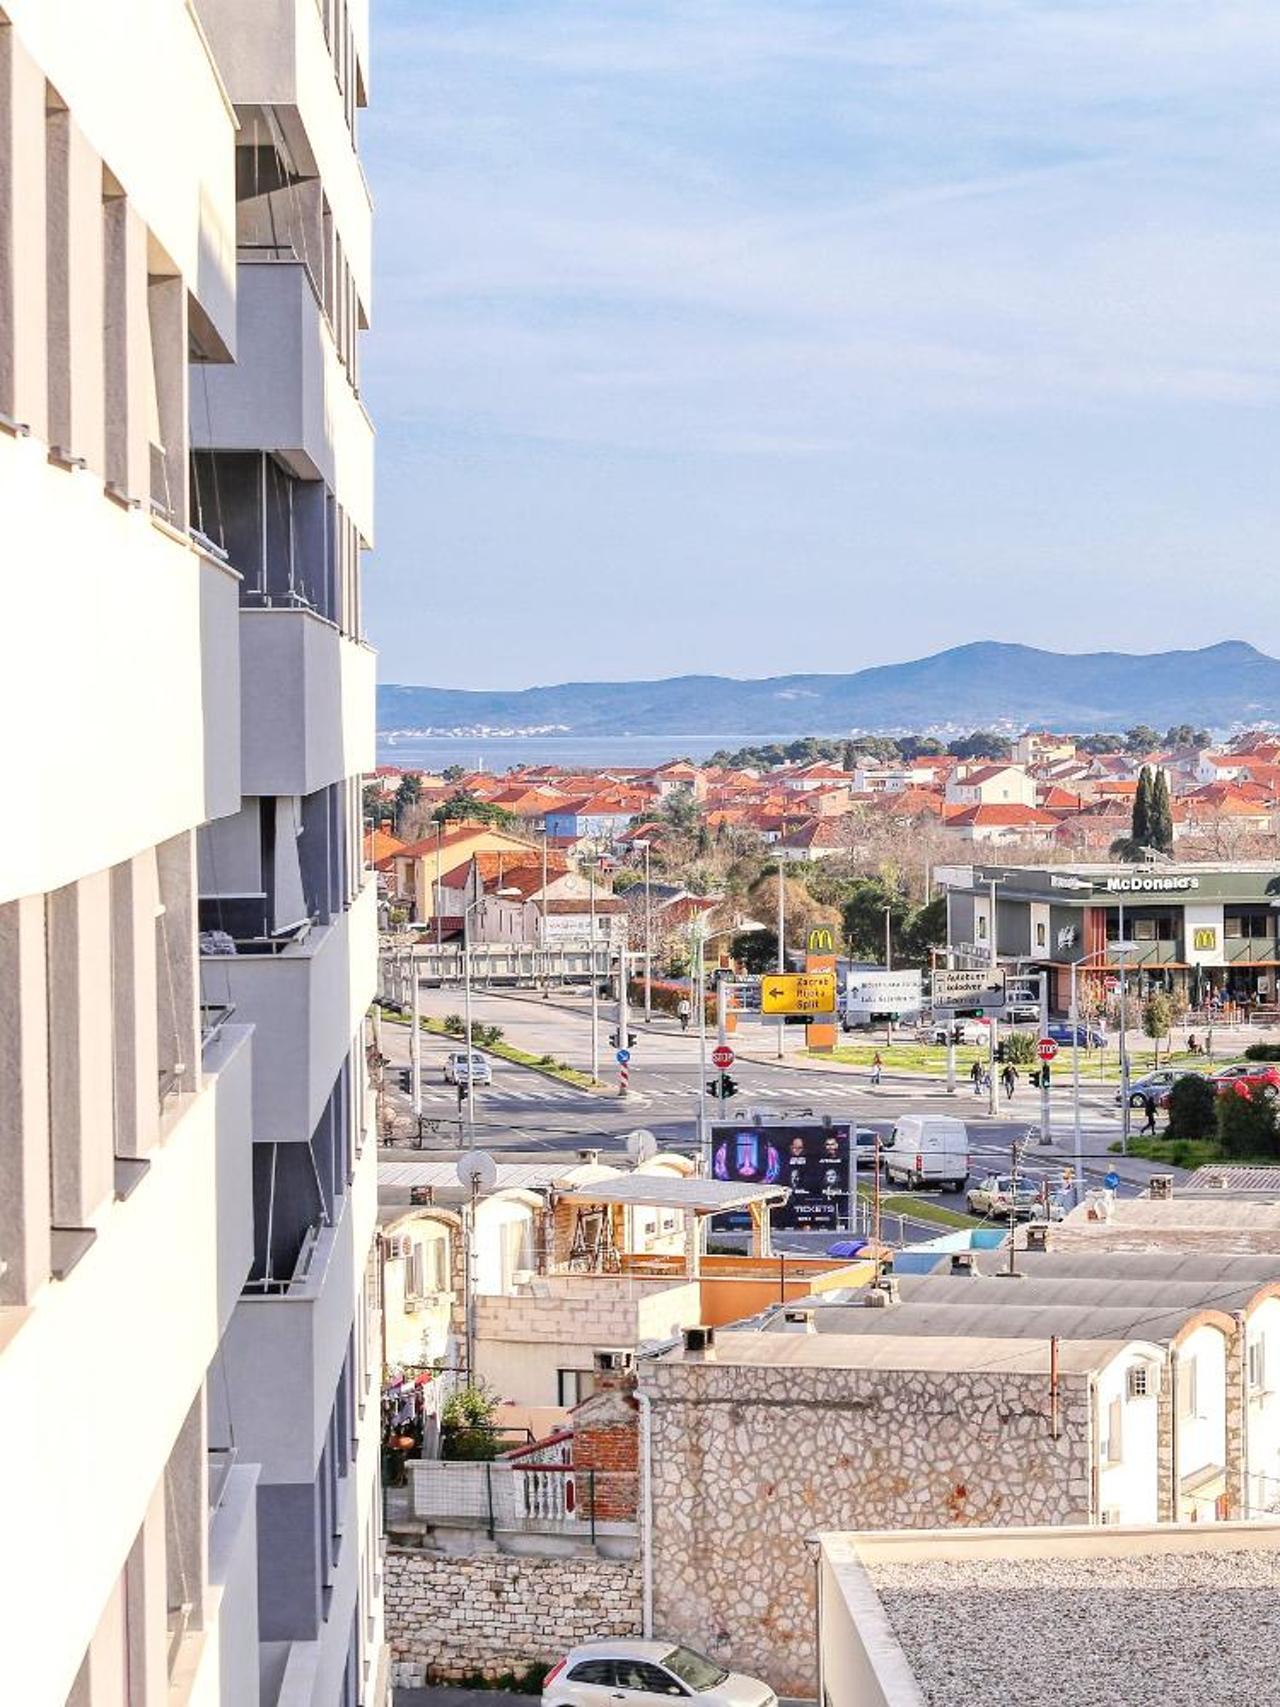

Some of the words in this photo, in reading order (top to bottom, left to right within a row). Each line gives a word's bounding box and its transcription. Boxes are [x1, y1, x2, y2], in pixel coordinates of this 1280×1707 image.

[1106, 876, 1199, 891] McDonald's
[797, 1001, 819, 1010] Split
[1037, 1044, 1059, 1055] STOP
[712, 1053, 734, 1062] STOP
[793, 1204, 835, 1213] TICKETS
